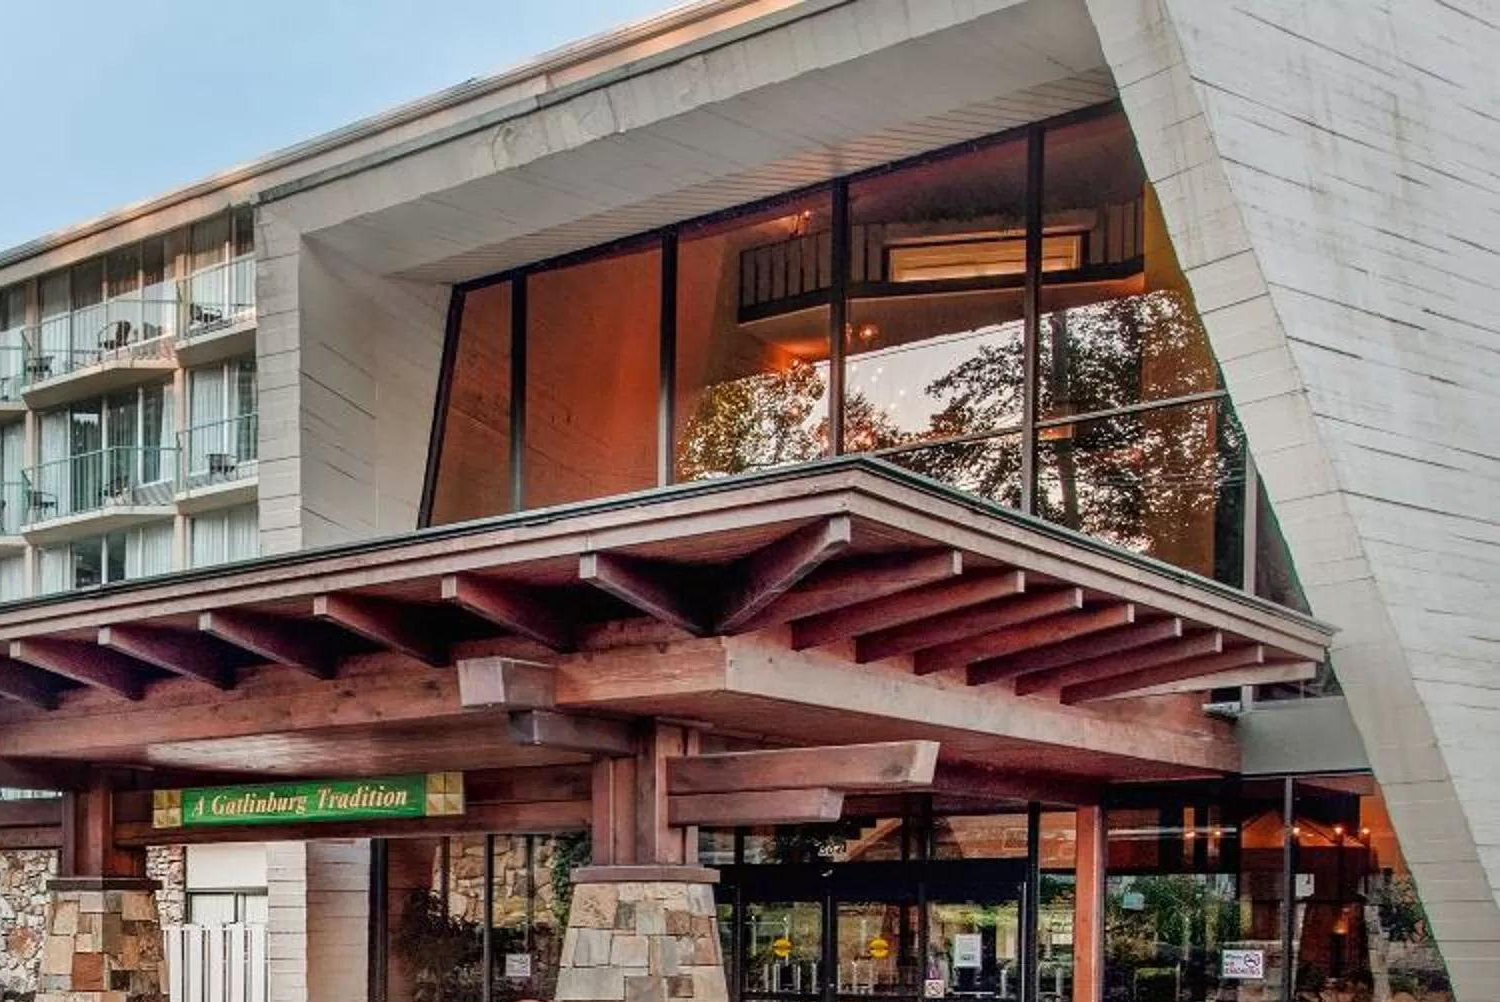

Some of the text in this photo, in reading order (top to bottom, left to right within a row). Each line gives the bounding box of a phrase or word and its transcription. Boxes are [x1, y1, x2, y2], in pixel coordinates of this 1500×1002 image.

[192, 785, 407, 817] A Gatlinburg Tradition
